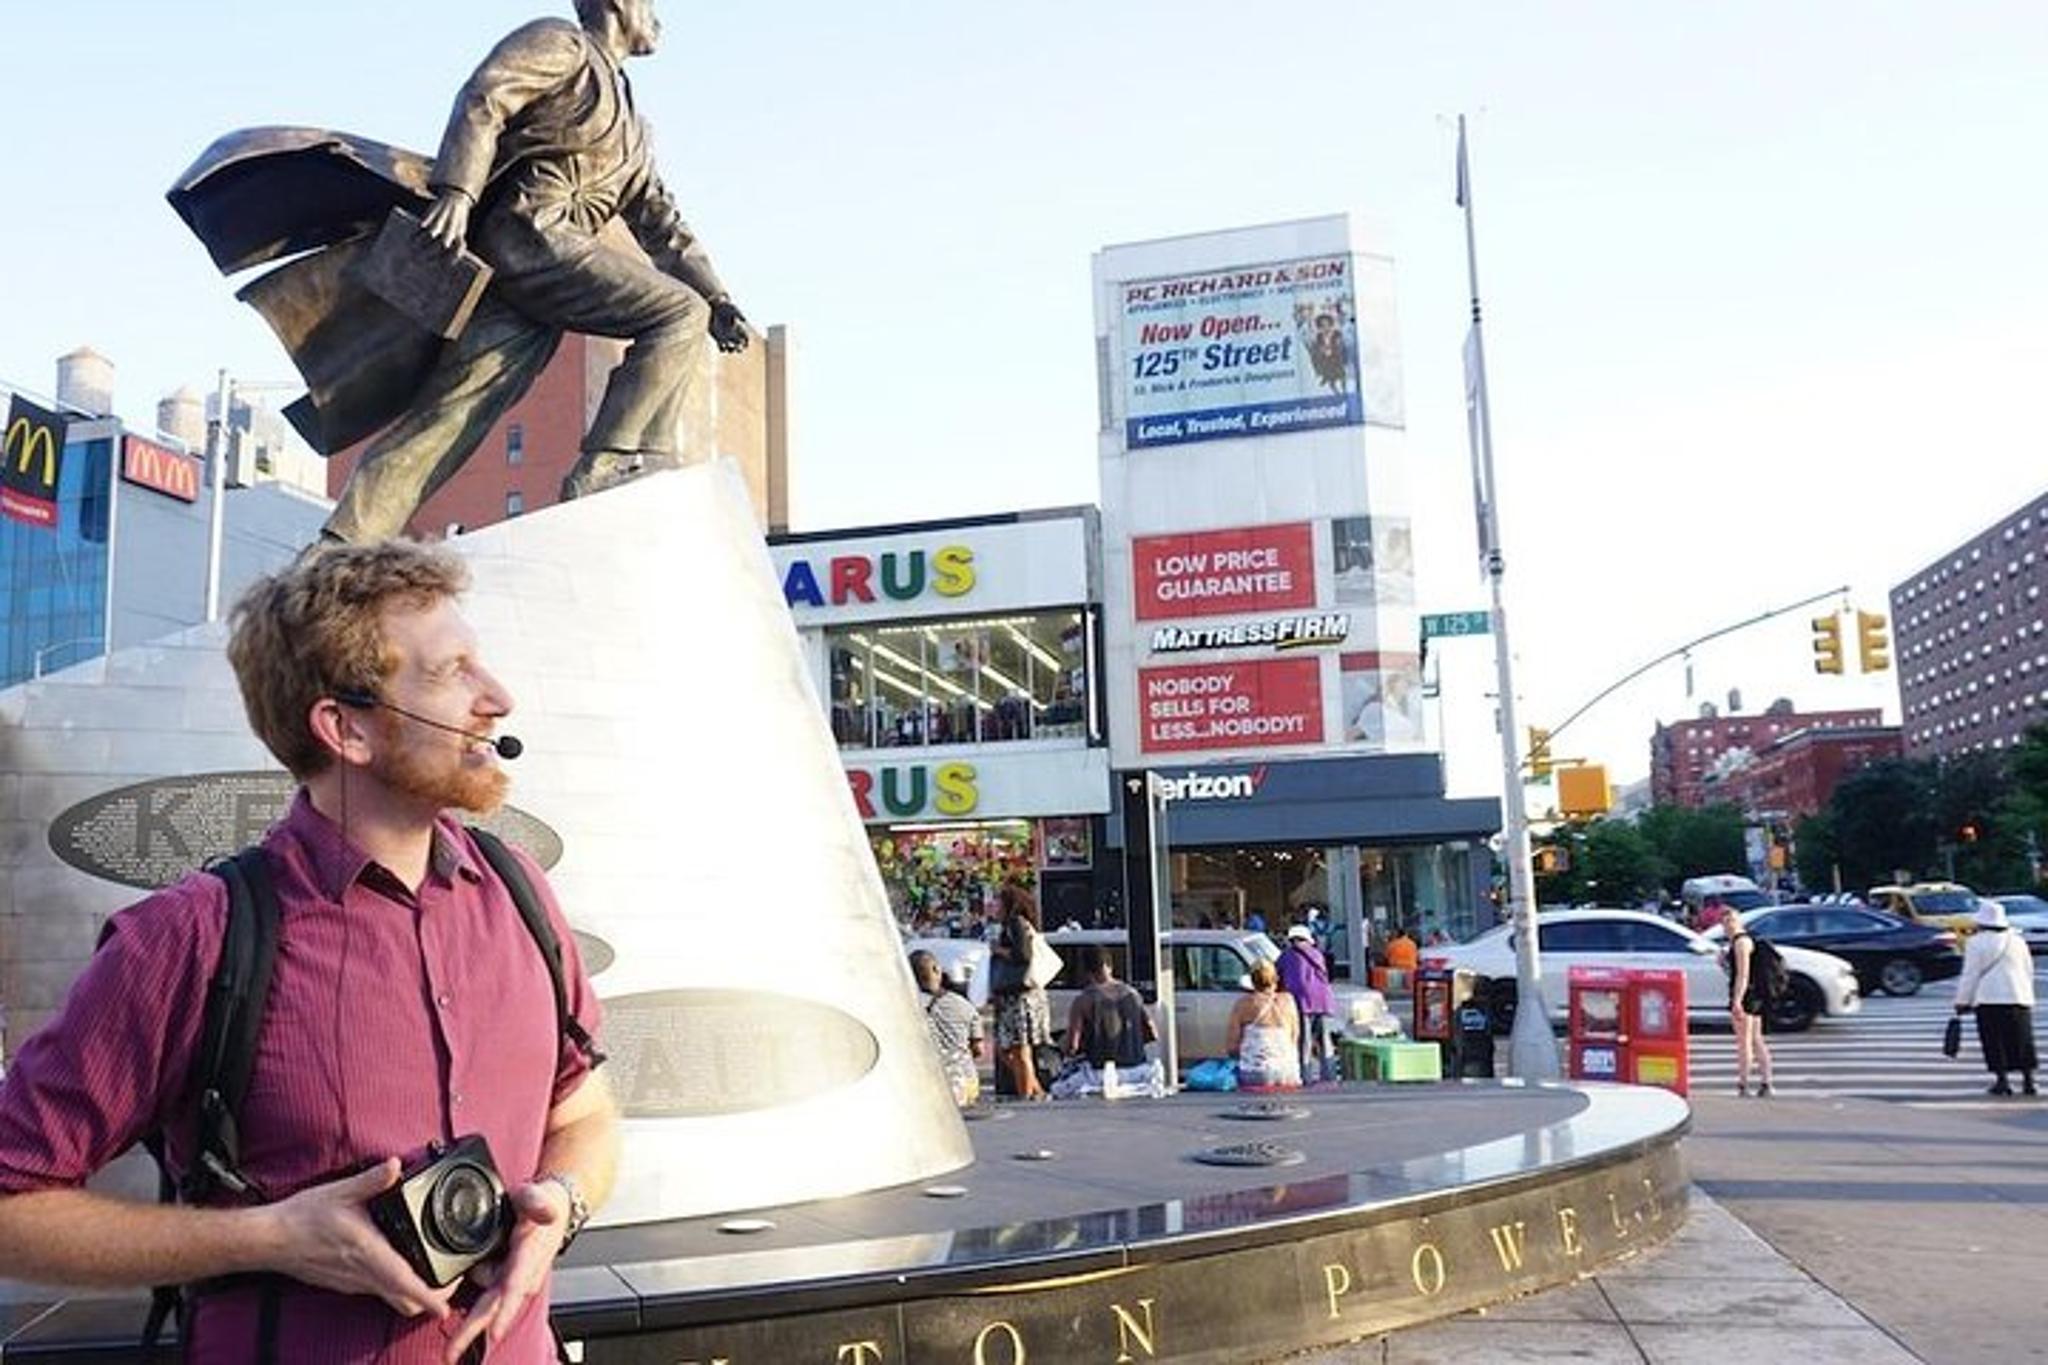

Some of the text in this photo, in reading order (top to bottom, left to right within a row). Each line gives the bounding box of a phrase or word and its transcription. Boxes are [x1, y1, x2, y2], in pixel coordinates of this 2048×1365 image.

[1126, 261, 1346, 303] PC RICHARD & SON
[1140, 314, 1281, 344] Now Open...
[1202, 336, 1293, 371] Street
[1138, 402, 1347, 439] Local, Trusted, Experienced
[783, 545, 977, 608] ARUS
[1156, 548, 1279, 577] LOW PRICE
[1157, 571, 1292, 600] GUARANTEE
[1444, 616, 1469, 633] 125
[1149, 674, 1233, 697] NOBODY
[1150, 695, 1250, 719] SELLS FOR
[846, 762, 979, 819] RUS
[1158, 770, 1253, 801] erizon
